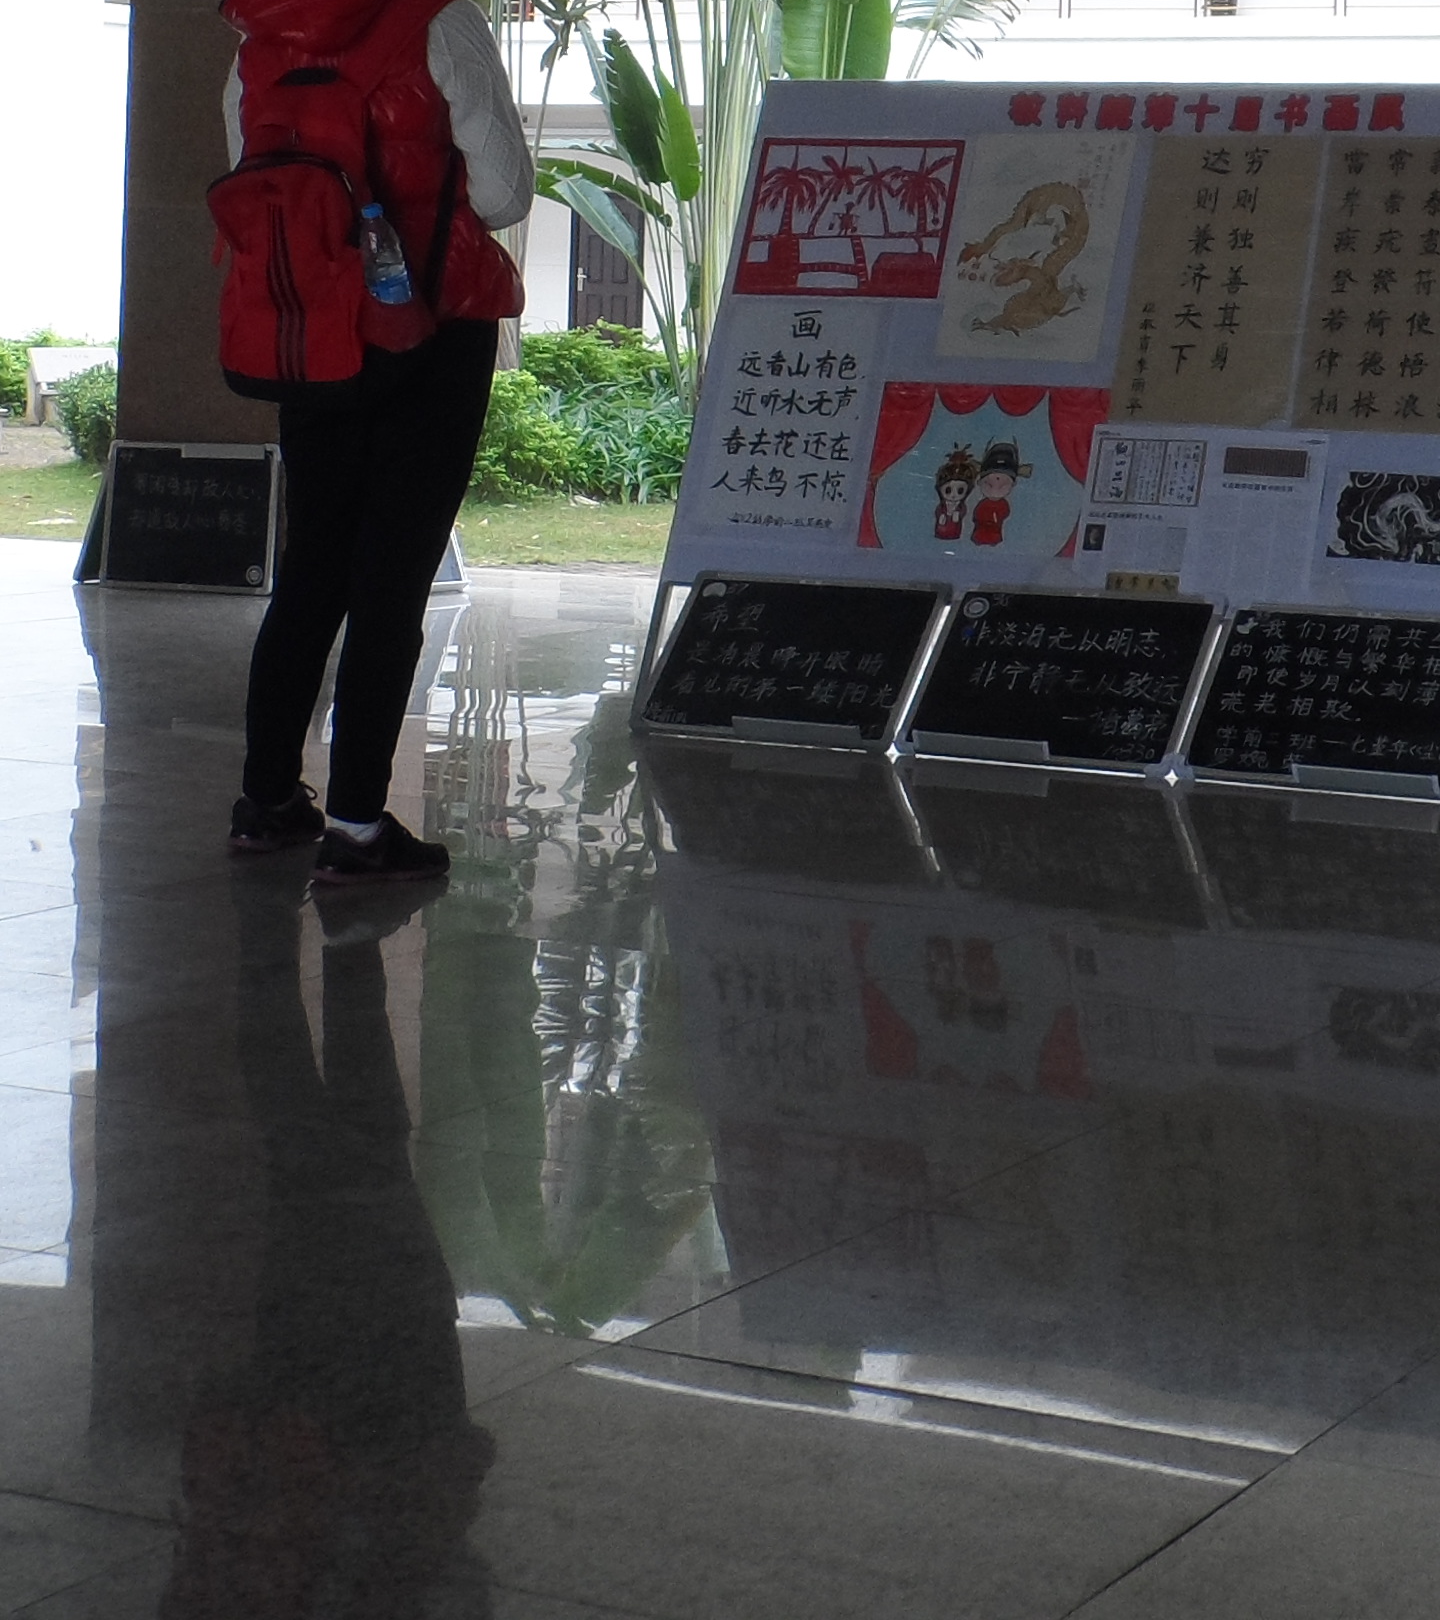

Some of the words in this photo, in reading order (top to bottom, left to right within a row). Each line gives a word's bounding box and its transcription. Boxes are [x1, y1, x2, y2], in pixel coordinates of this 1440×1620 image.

[791, 309, 823, 341] 画
[1170, 147, 1231, 374] 达则兼济天下
